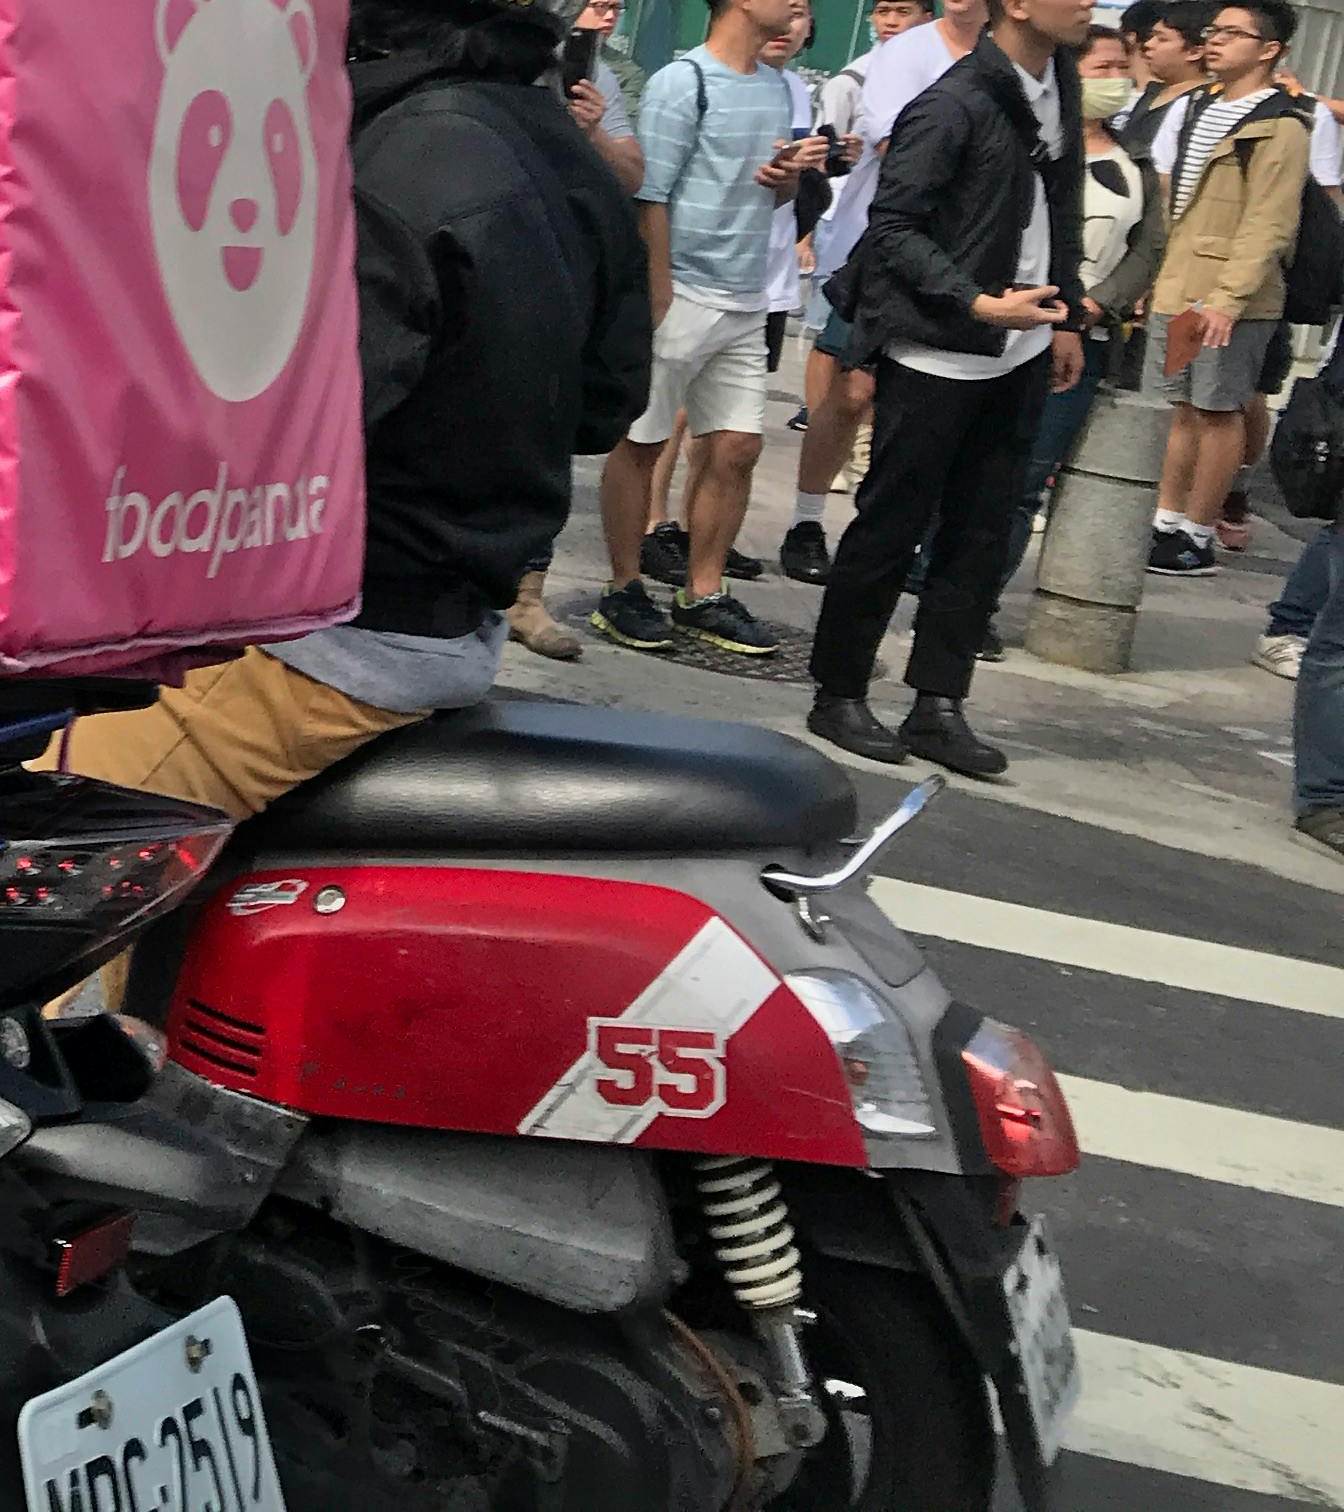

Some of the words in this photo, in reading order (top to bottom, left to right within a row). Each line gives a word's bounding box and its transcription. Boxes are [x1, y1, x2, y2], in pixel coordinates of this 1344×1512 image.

[101, 461, 330, 579] foodpanda
[588, 1016, 728, 1120] 55
[44, 1373, 261, 1512] C-2519
